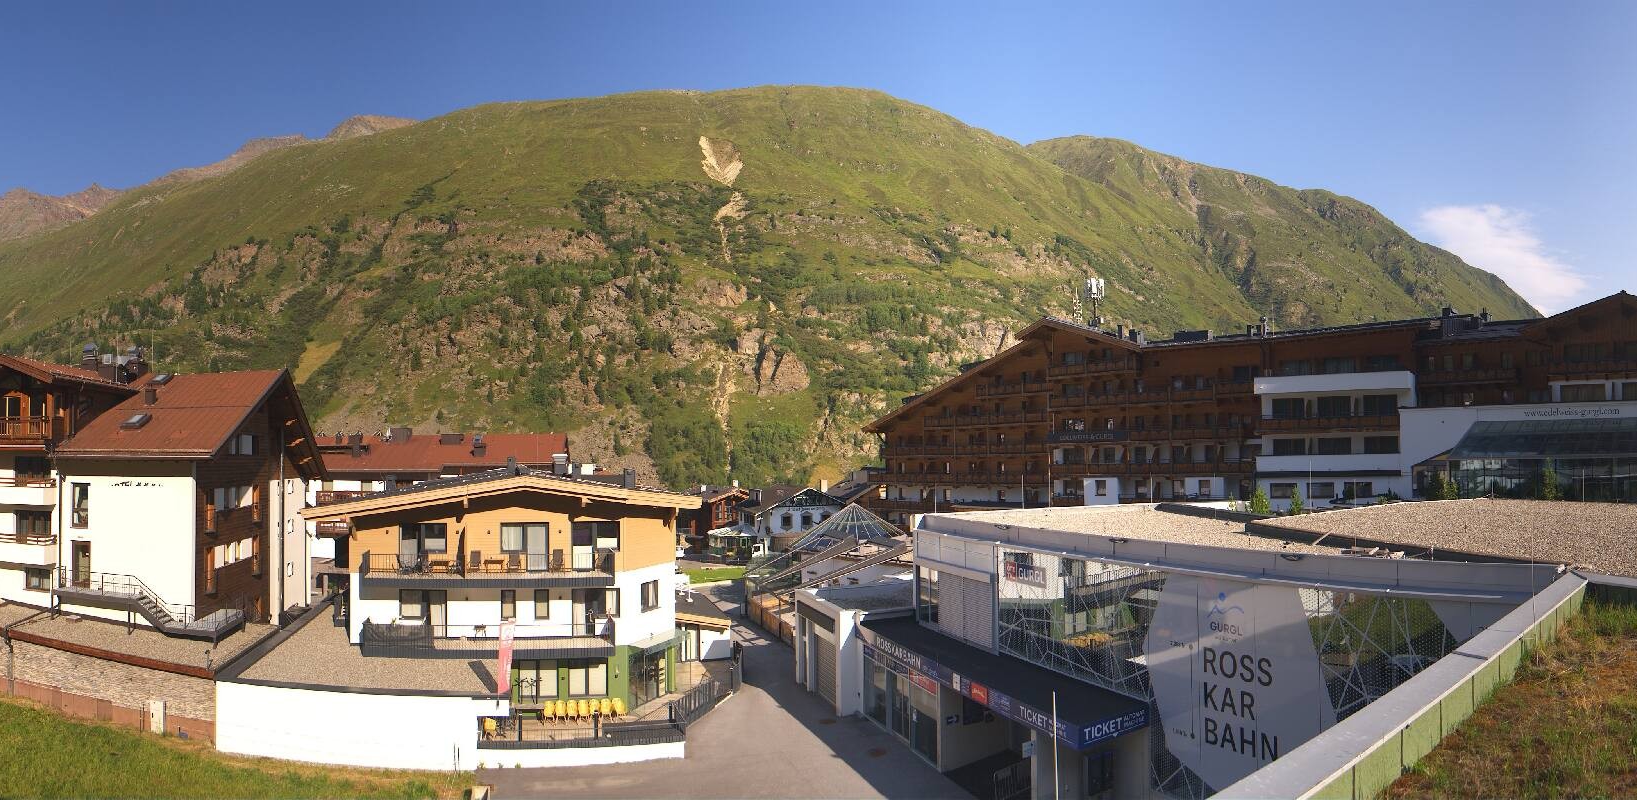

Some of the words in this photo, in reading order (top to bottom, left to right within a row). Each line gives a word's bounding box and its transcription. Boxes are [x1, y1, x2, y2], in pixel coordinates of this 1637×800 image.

[1018, 567, 1045, 584] GURGL
[1210, 621, 1243, 637] GURGL
[876, 636, 921, 669] ROSSKARBAHN
[1203, 647, 1273, 687] ROSS
[1203, 682, 1256, 721] KAR
[1019, 705, 1047, 729] TICKET
[1083, 717, 1122, 741] TICKET
[1205, 718, 1278, 762] BAHN
